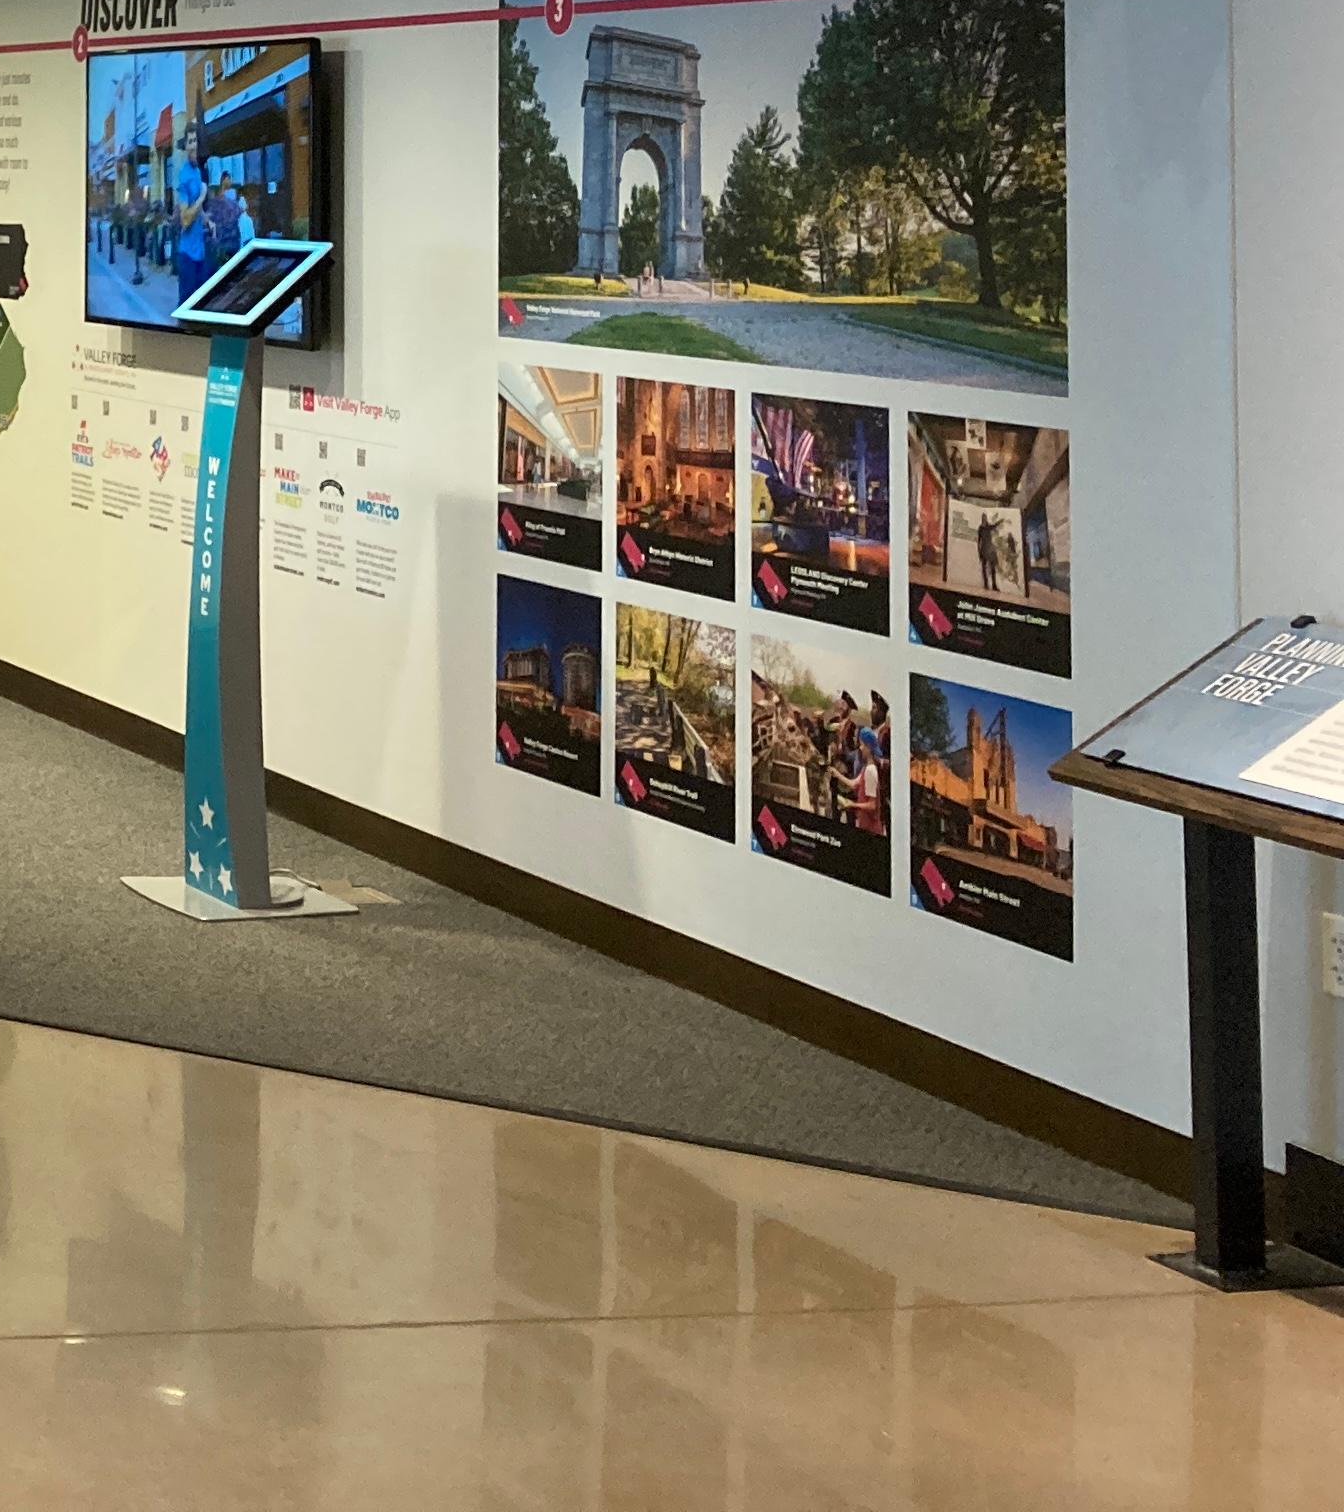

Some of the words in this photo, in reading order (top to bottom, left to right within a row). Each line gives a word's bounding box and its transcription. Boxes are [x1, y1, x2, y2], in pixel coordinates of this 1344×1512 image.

[554, 0, 564, 23] 3
[77, 34, 84, 53] 2
[84, 348, 110, 364] VALLEY
[113, 352, 137, 368] FORGE
[317, 394, 334, 408] Visit
[336, 396, 358, 416] Valley
[361, 401, 383, 419] Forge
[385, 405, 400, 422] App
[72, 453, 94, 467] TRAILS
[274, 467, 296, 482] MAKE
[280, 481, 299, 494] MAIN
[320, 501, 344, 513] MONTCO
[199, 456, 221, 617] WELCOME
[821, 571, 848, 587] Discovery
[849, 577, 869, 589] Center
[957, 600, 971, 610] John
[975, 603, 995, 614] James
[1026, 614, 1049, 626] Center
[1233, 652, 1325, 685] VALLEY
[1201, 673, 1285, 705] FORGE
[815, 831, 829, 845] Park
[830, 835, 841, 847] Zoo
[983, 886, 998, 899] Main
[999, 891, 1020, 907] Street
